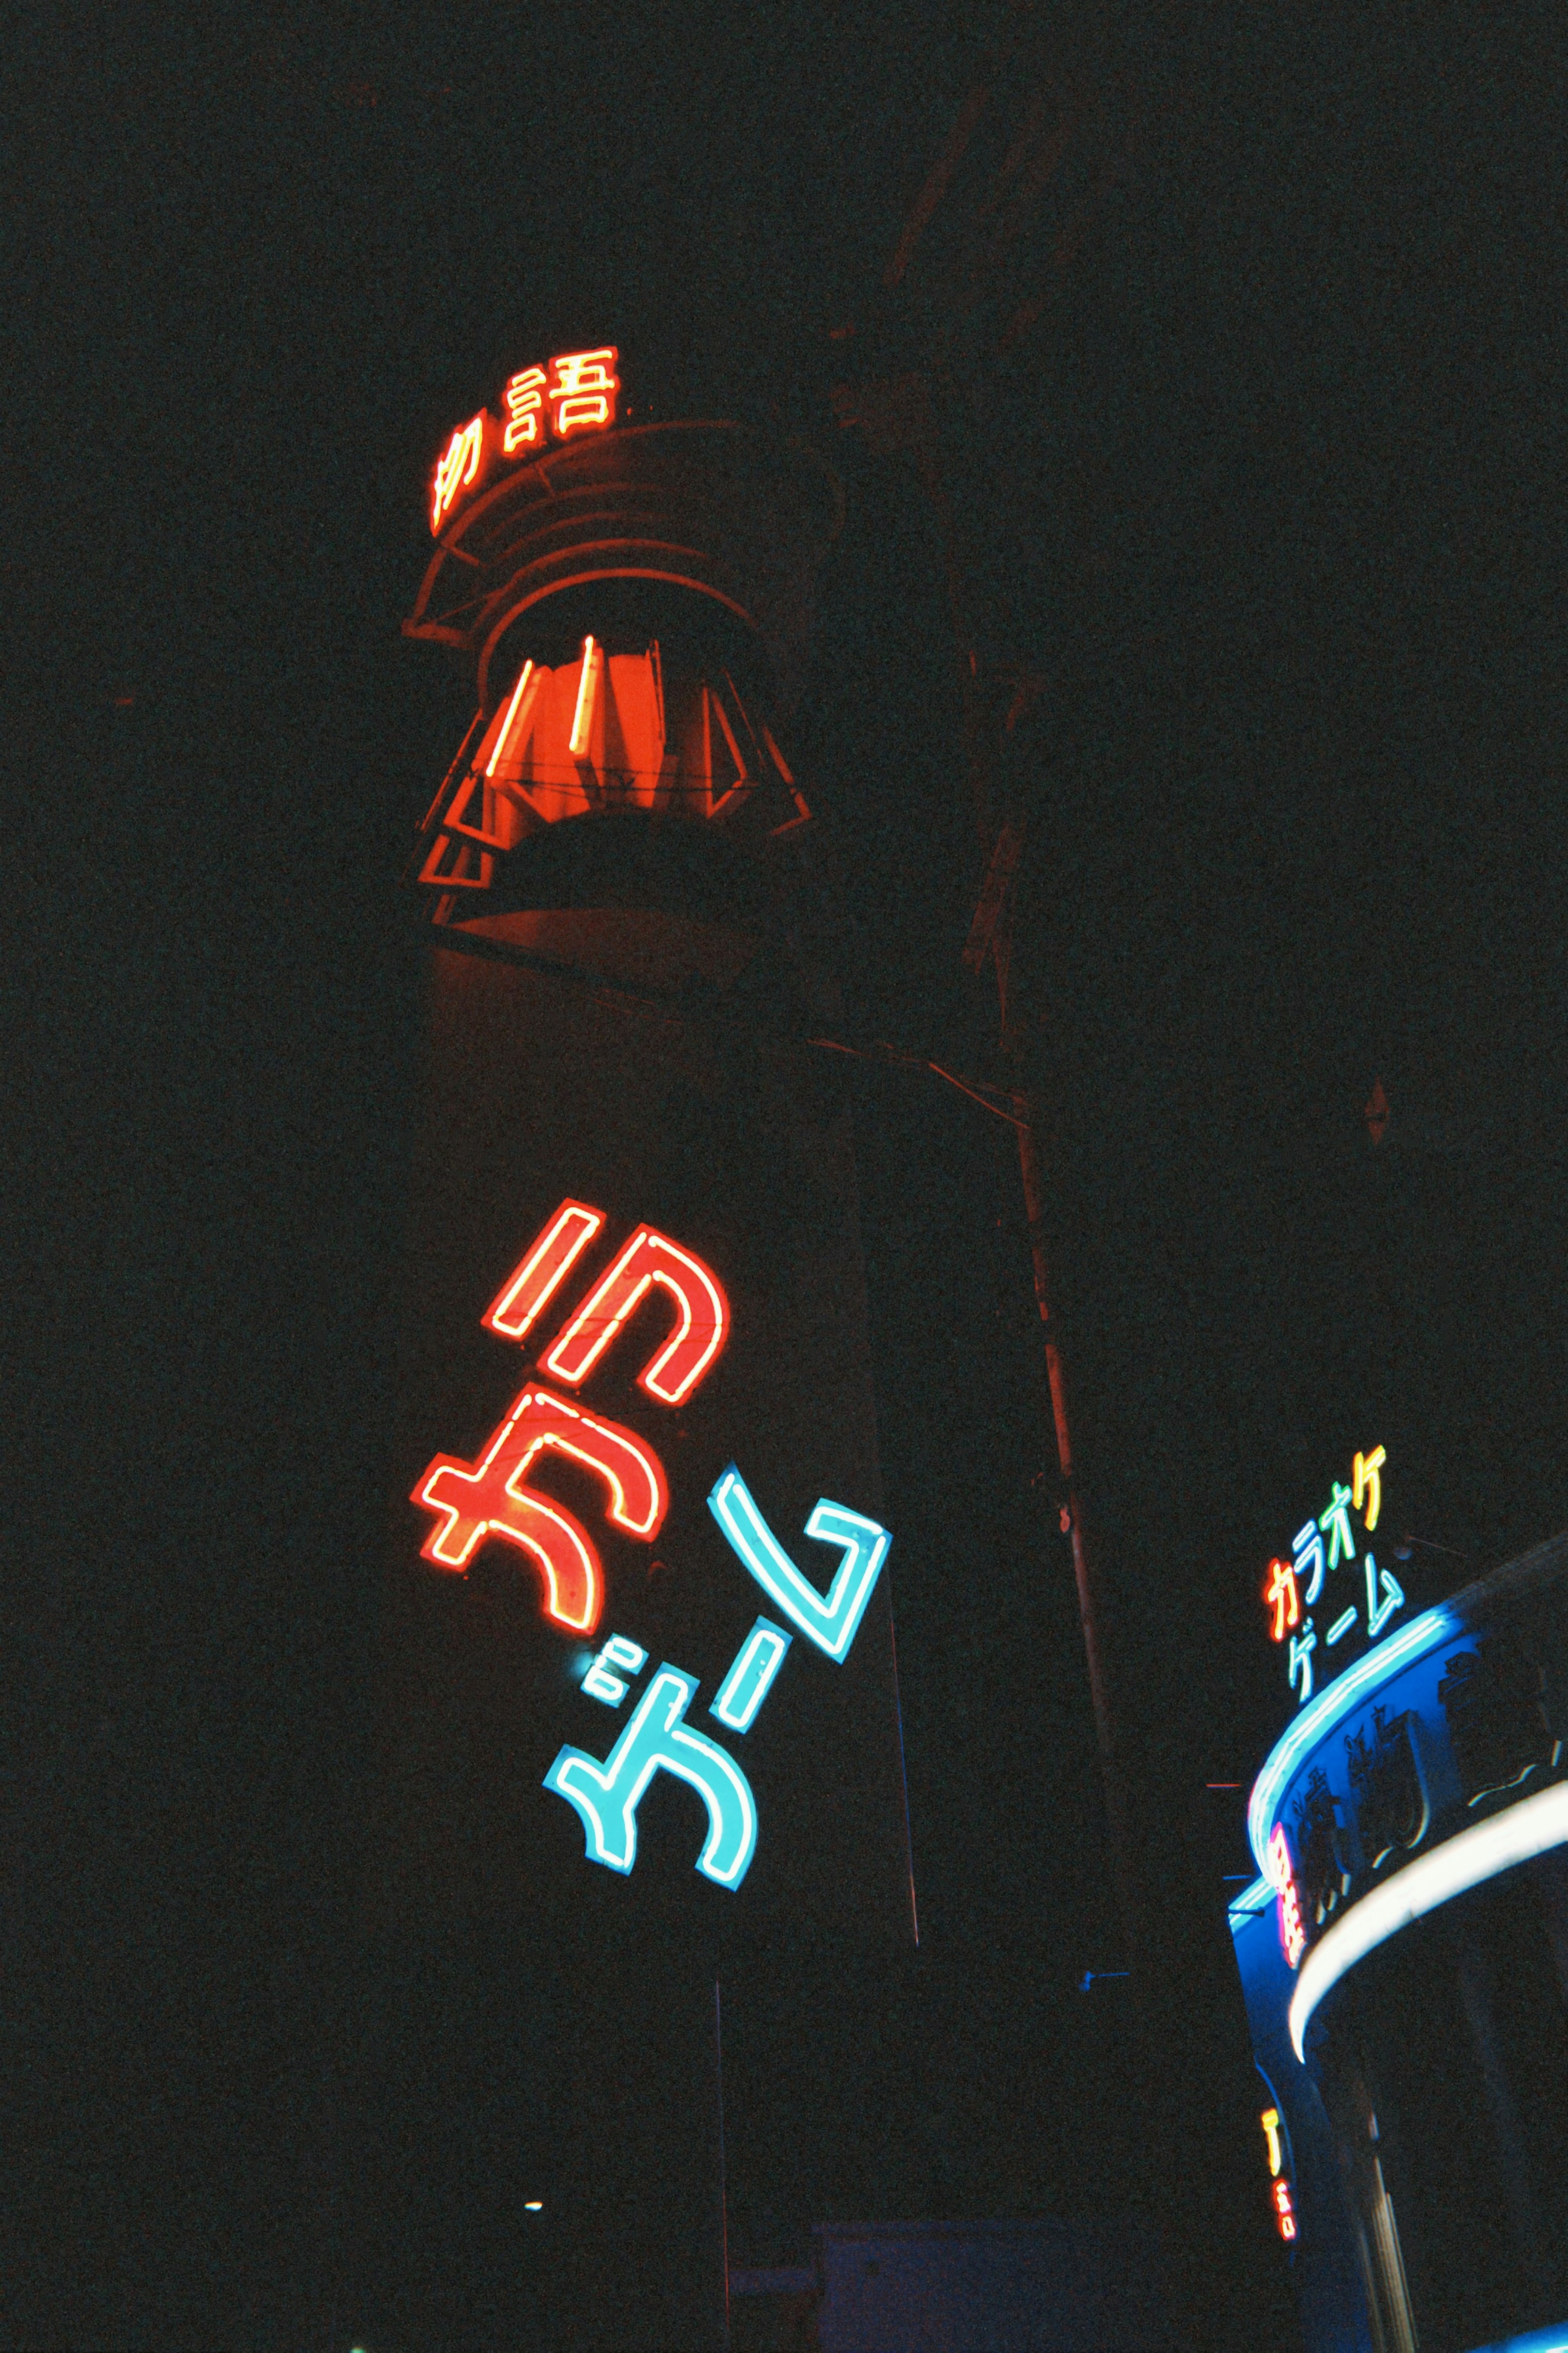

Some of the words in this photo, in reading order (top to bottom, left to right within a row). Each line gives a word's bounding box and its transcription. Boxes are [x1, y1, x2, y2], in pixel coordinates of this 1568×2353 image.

[430, 346, 620, 538] 物語
[410, 1198, 730, 1635] カラ
[1267, 1444, 1386, 1642] カラオケ
[1289, 1552, 1405, 1703] ゲーム
[543, 1461, 893, 1891] ゲーム
